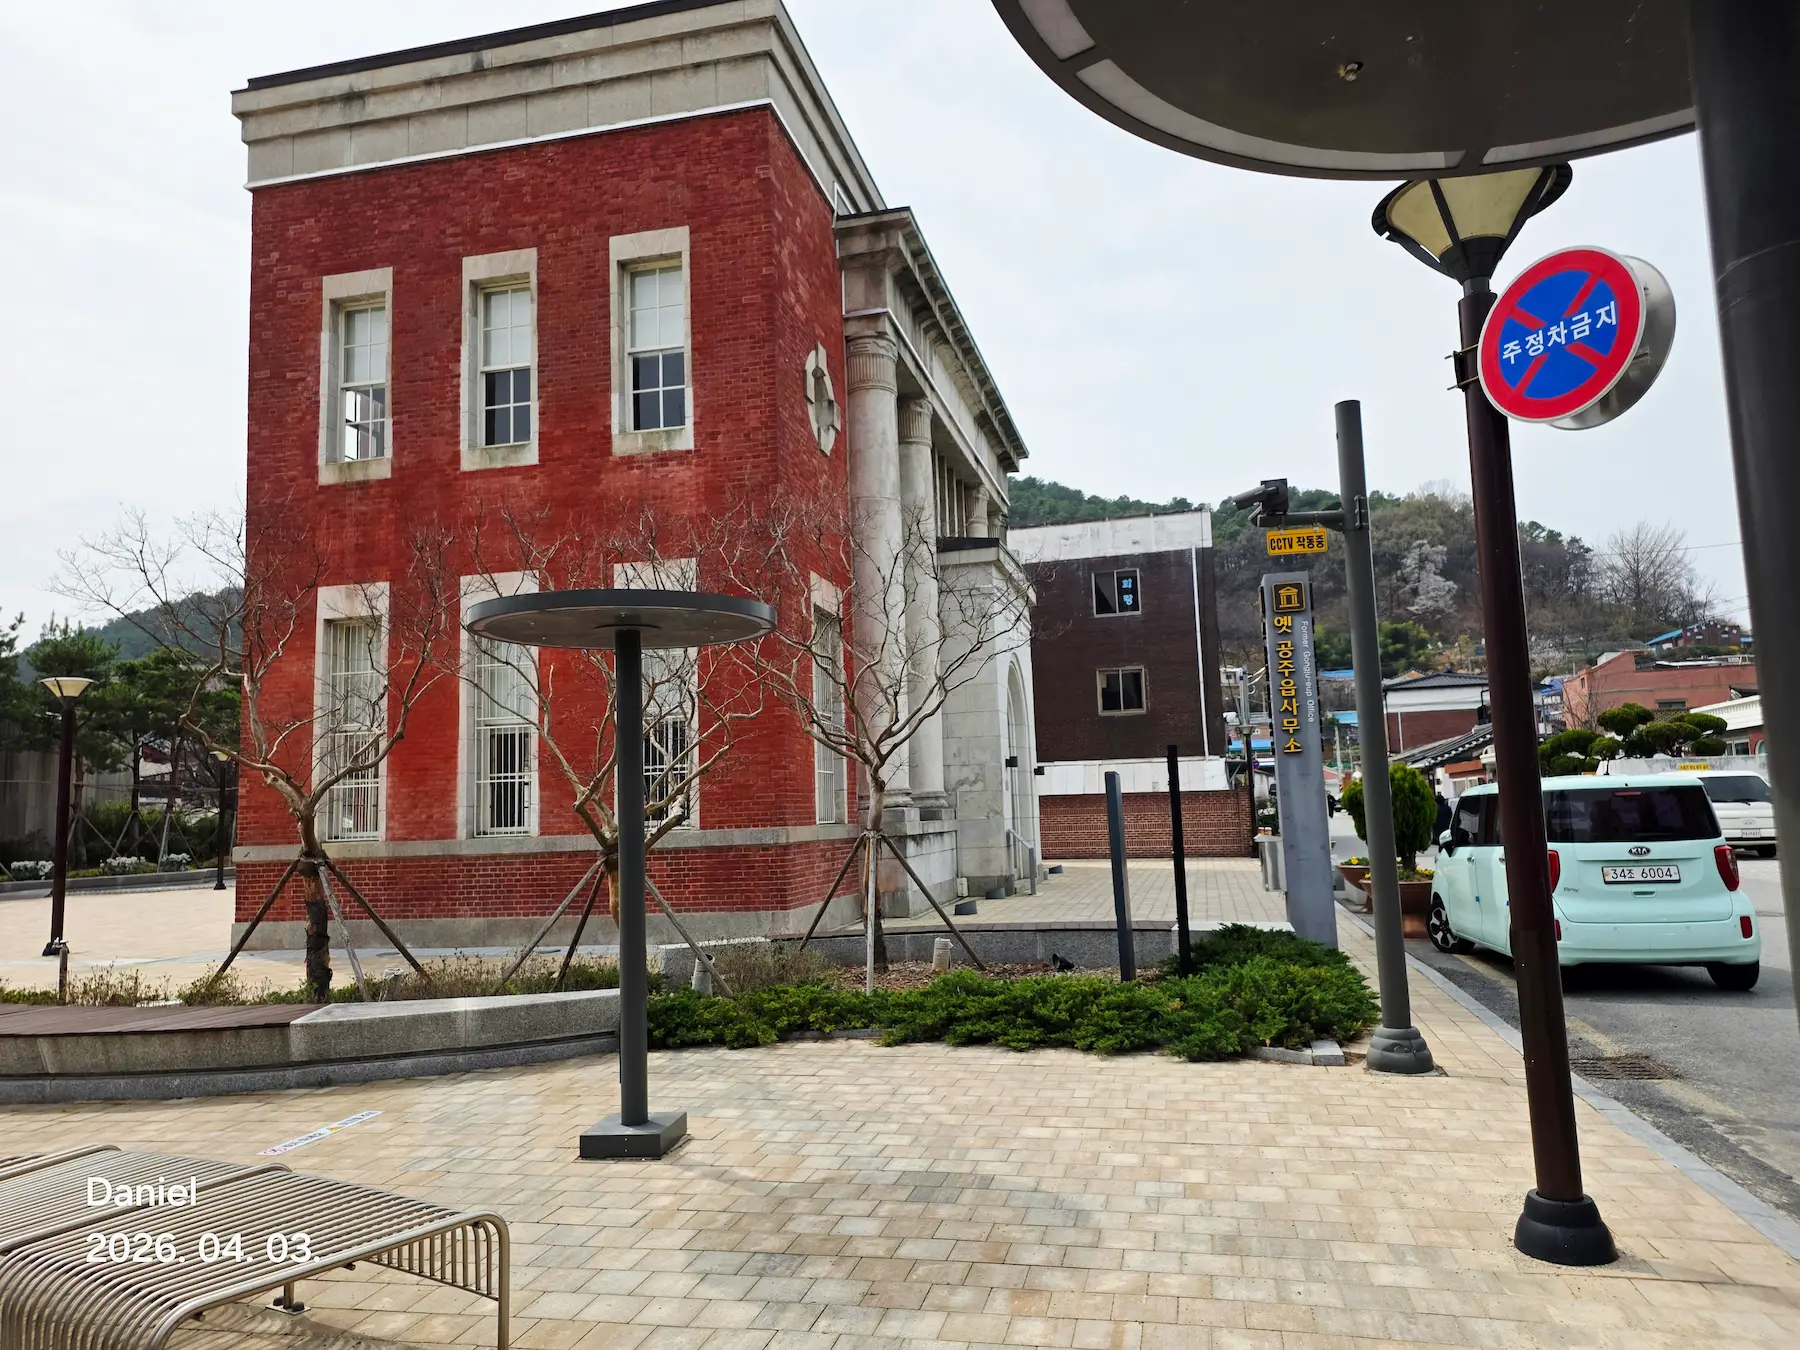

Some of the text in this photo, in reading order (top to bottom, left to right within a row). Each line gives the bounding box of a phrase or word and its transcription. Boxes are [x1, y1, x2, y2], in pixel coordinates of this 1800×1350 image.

[1502, 301, 1617, 365] 주정차금지
[1270, 534, 1324, 551] CCTV 작동중
[1274, 615, 1302, 753] 옛 공주읍사무소
[1301, 620, 1315, 722] Former Gongju-eup Office
[1631, 847, 1648, 855] KIA
[1611, 867, 1672, 879] 34조 6004
